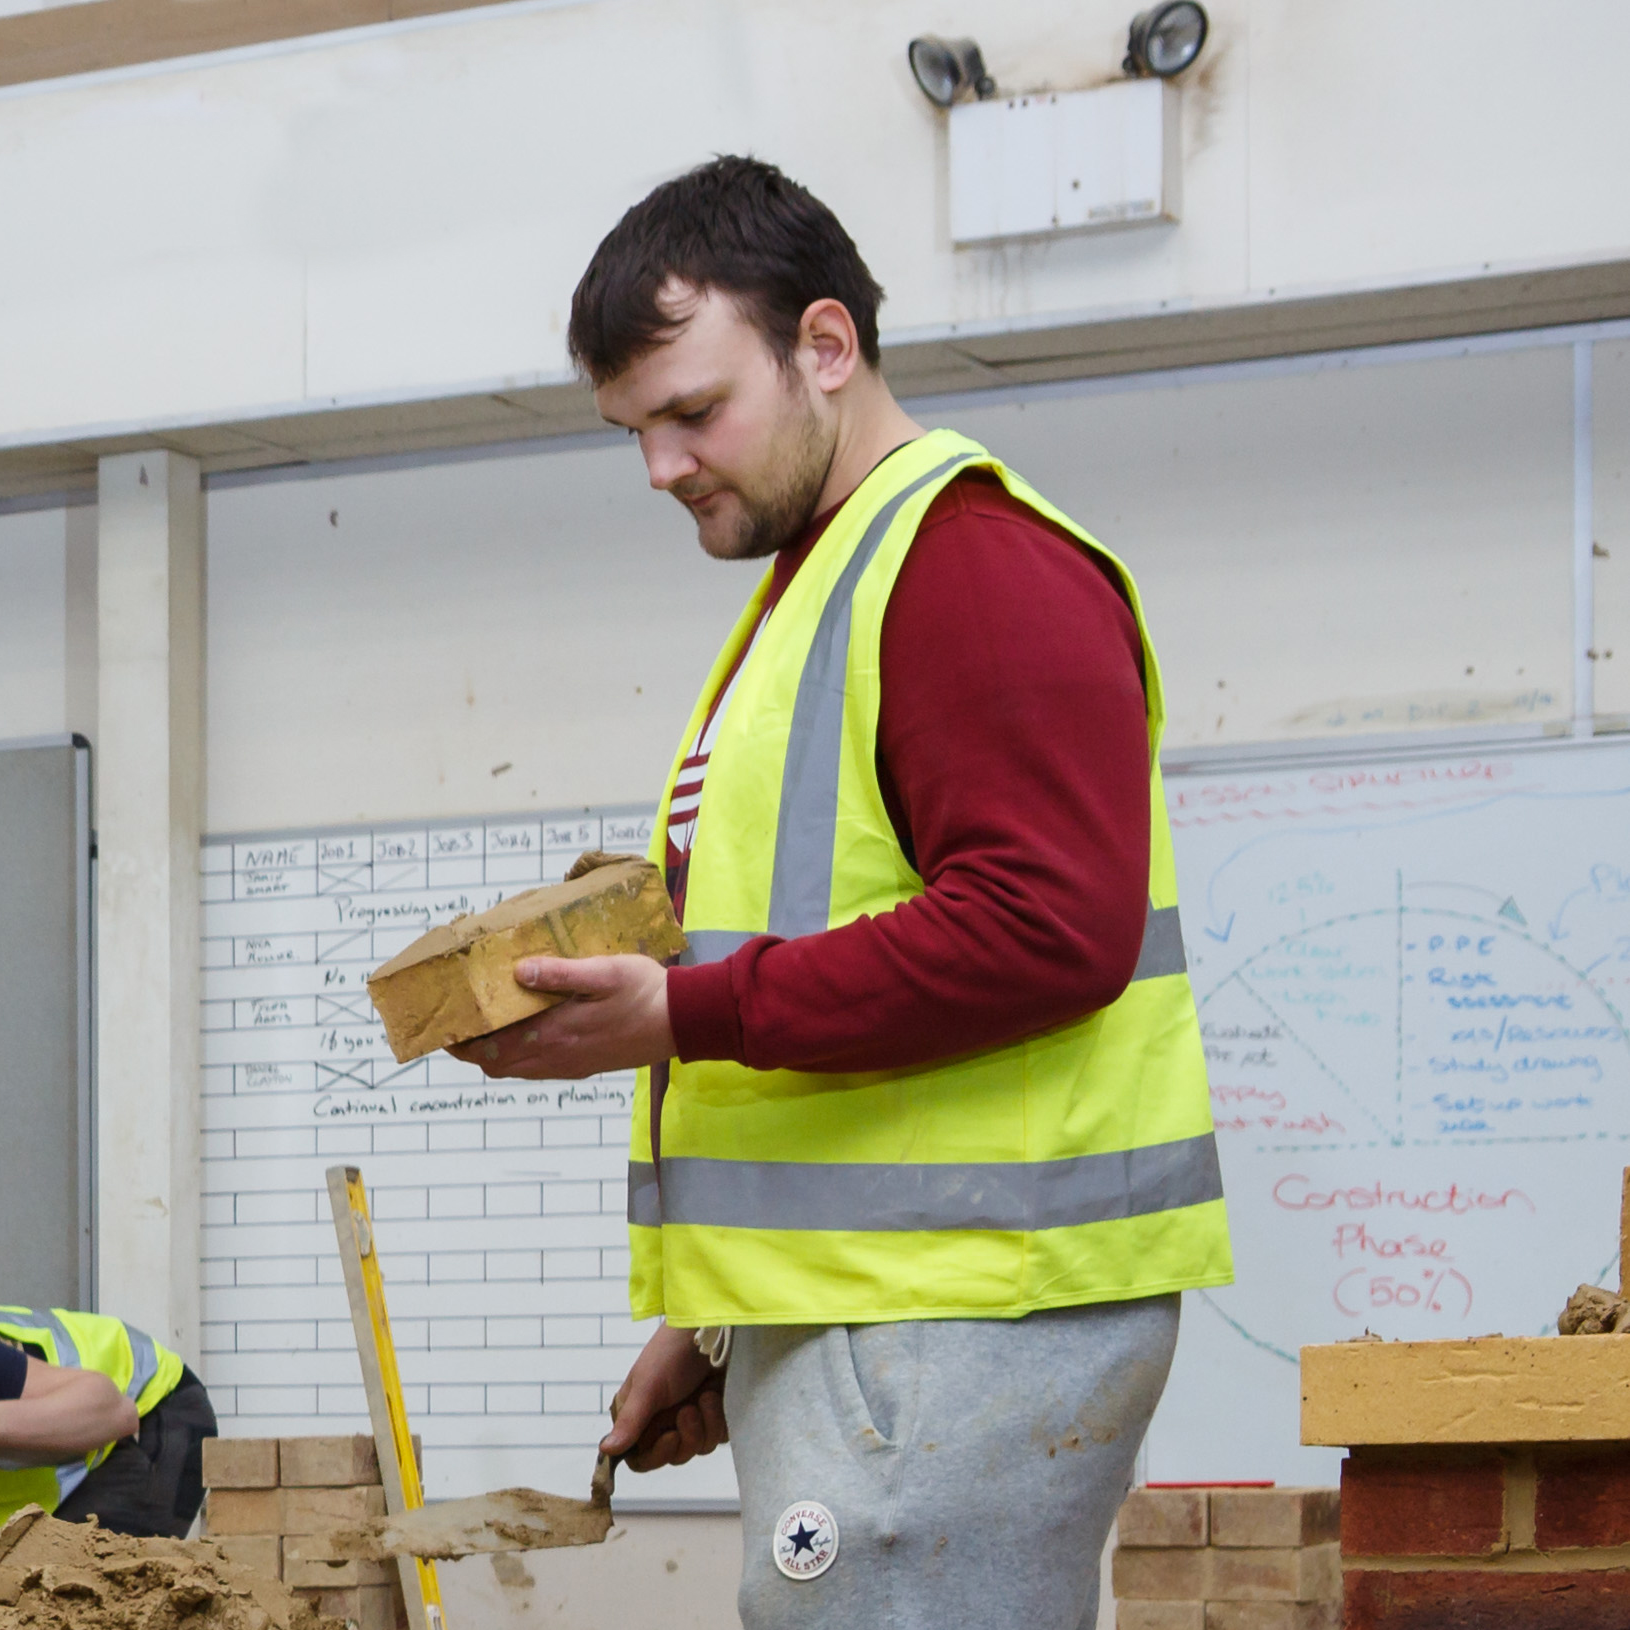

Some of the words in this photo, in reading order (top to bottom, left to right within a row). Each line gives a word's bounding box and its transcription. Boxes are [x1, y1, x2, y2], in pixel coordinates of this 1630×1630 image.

[1272, 1172, 1537, 1216] Construction
[1331, 1222, 1457, 1264] Phase
[781, 1509, 828, 1536] CONVERSE
[784, 1557, 801, 1571] ALL
[803, 1549, 829, 1571] STAR
